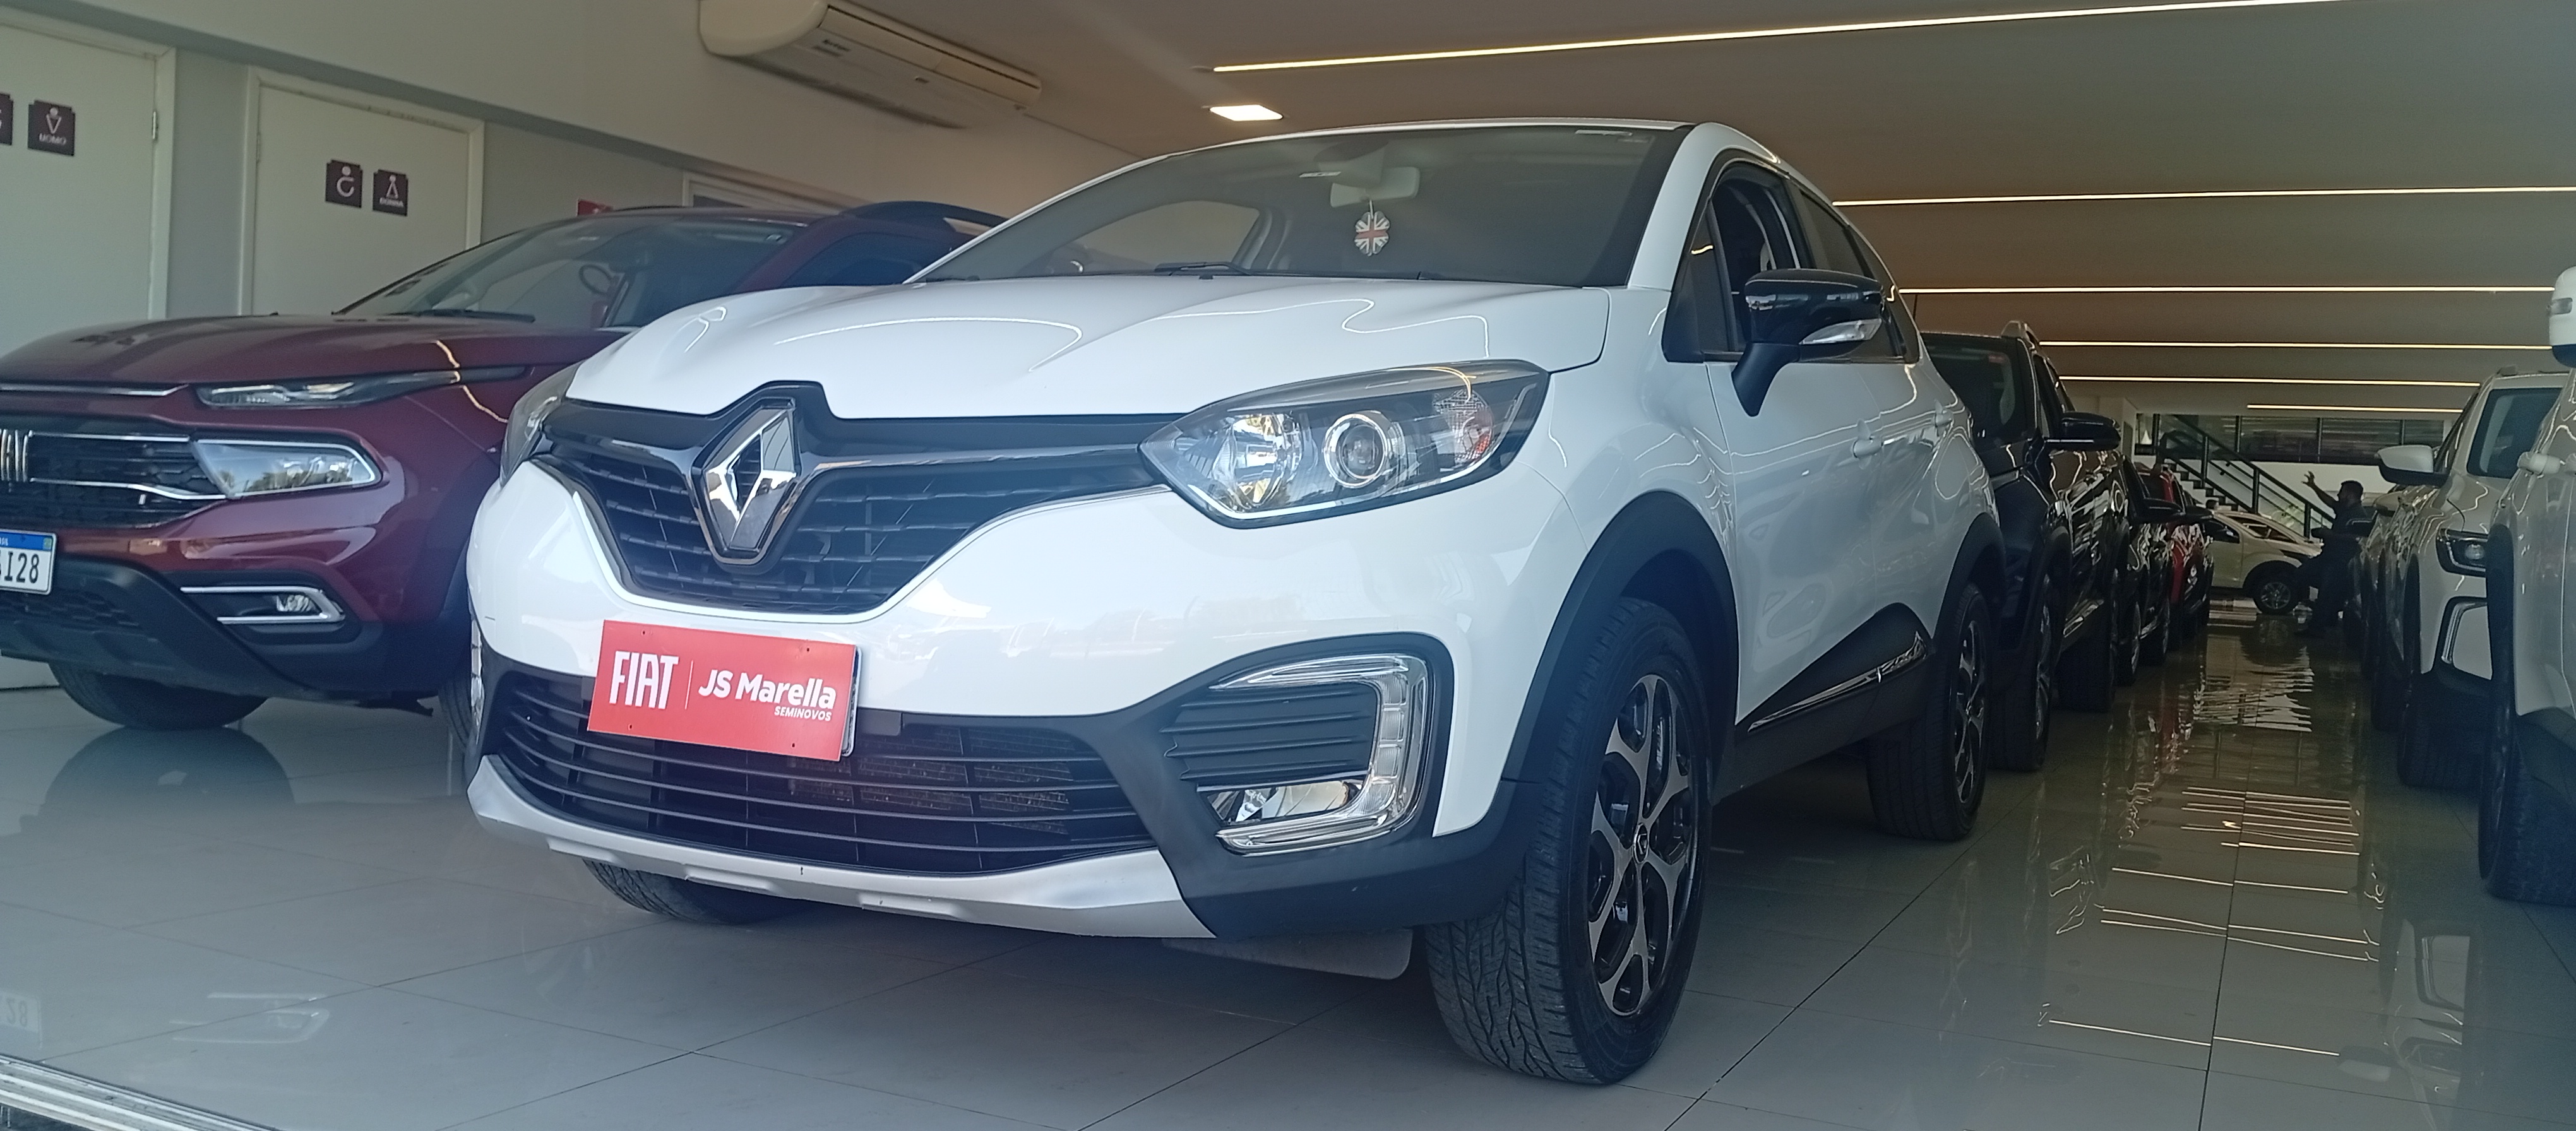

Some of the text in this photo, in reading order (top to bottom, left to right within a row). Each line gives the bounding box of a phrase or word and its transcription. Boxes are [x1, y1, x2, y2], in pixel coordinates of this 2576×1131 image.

[0, 550, 39, 584] I28
[609, 651, 679, 709] FIAT
[698, 670, 837, 709] JS Marella
[774, 706, 832, 721] SEMINOVOS
